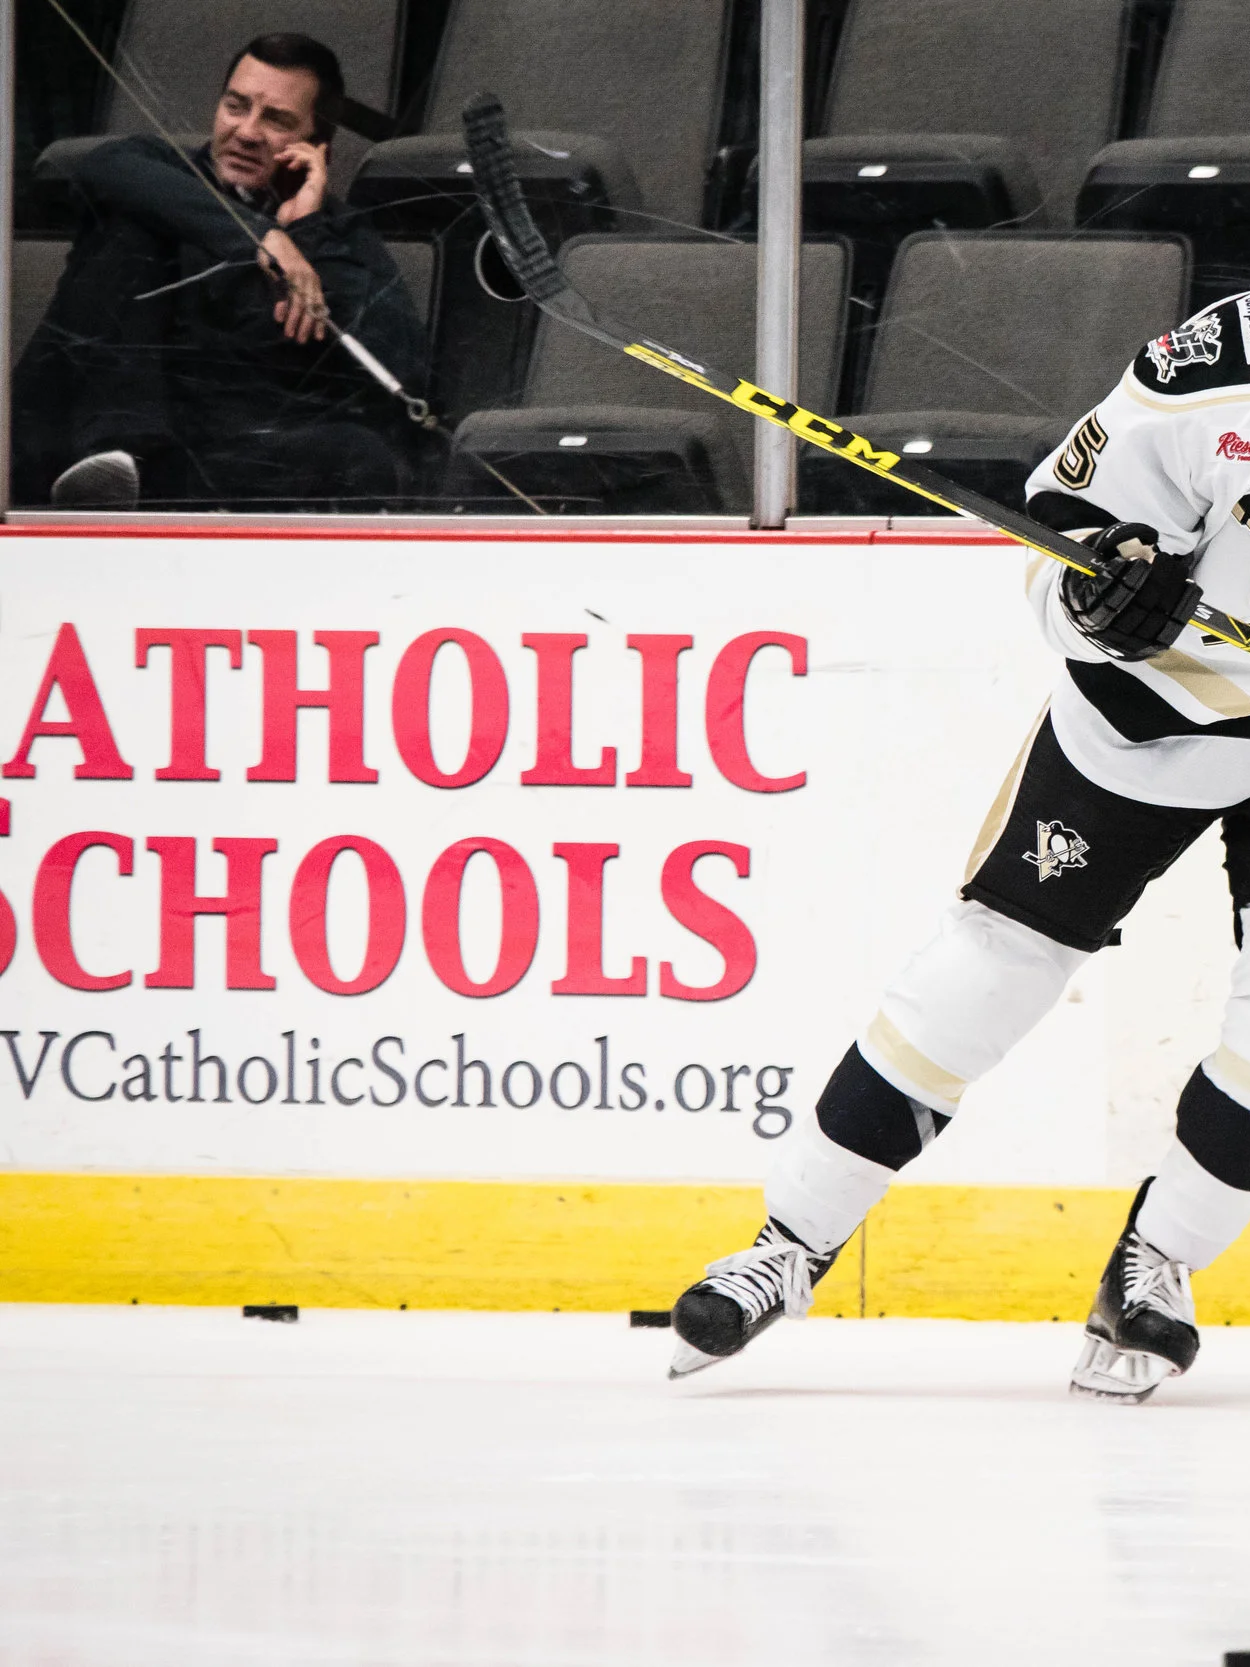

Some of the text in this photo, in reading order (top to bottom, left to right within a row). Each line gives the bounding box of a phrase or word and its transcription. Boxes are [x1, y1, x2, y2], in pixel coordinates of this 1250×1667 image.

[731, 378, 900, 471] CCM
[1053, 409, 1109, 491] 5
[0, 796, 758, 1003] CHOOLS
